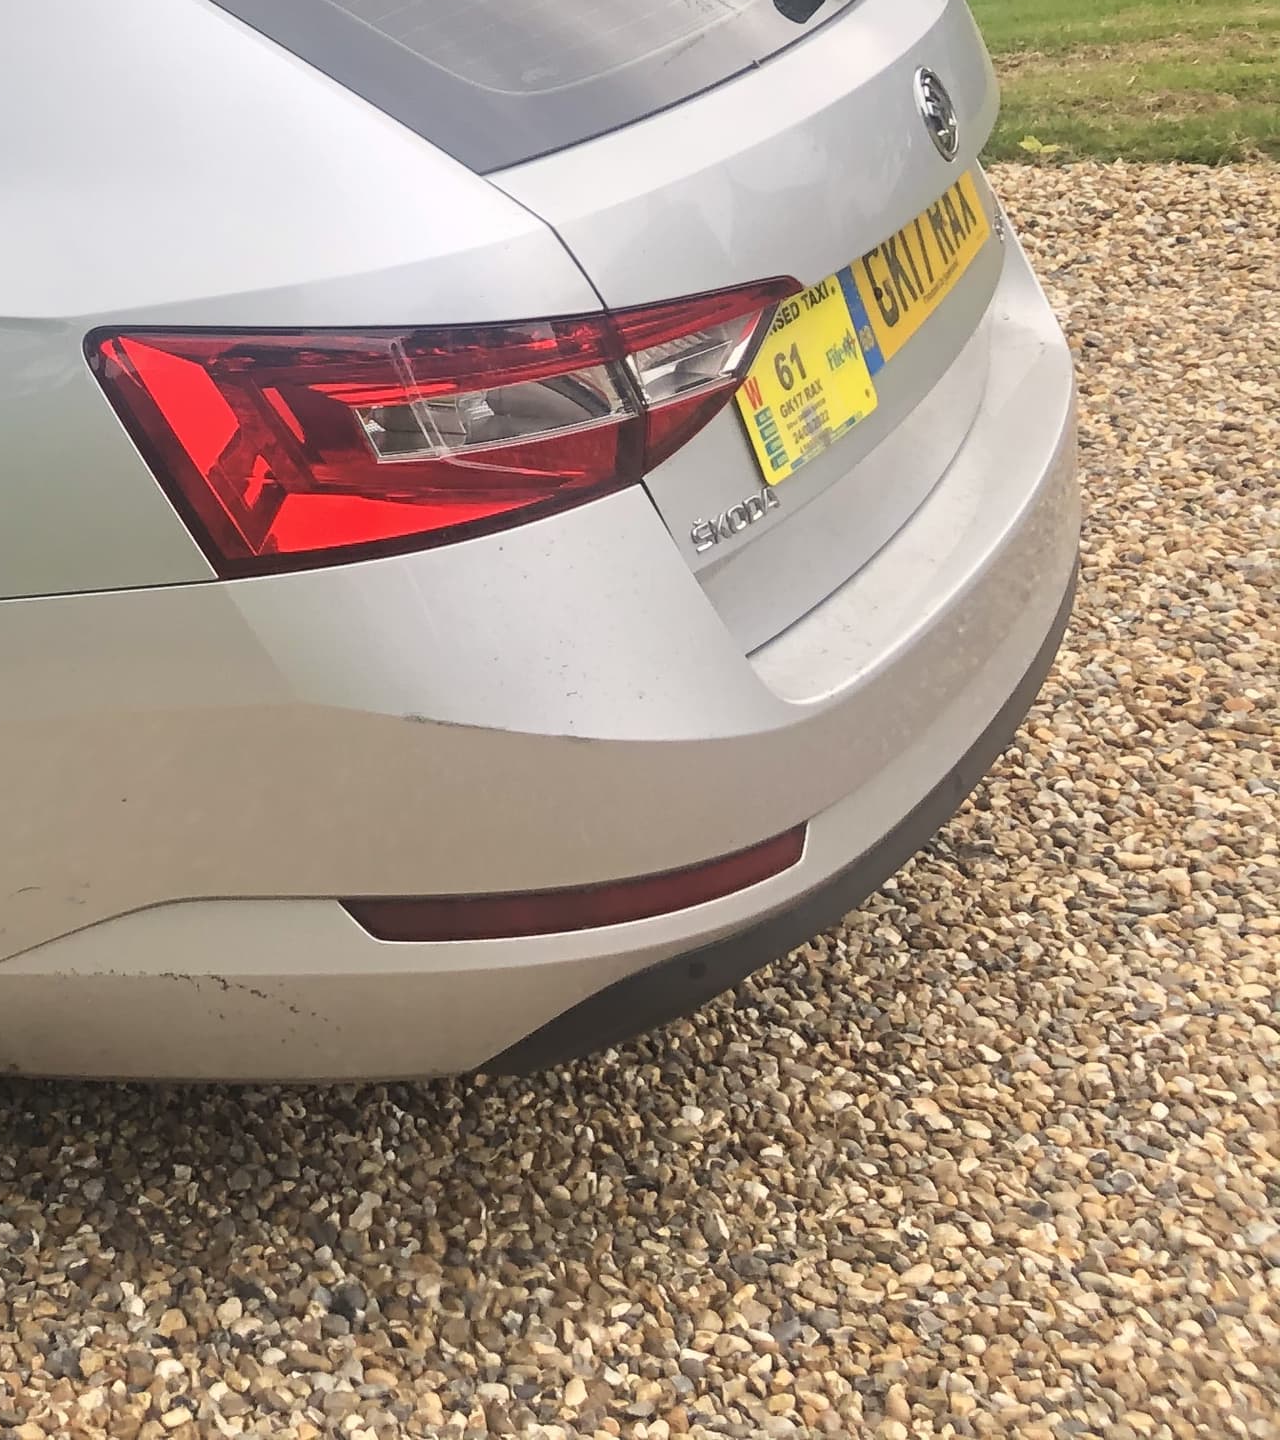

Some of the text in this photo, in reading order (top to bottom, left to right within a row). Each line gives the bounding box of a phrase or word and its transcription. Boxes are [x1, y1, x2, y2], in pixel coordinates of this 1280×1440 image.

[801, 281, 829, 311] TAXI
[774, 342, 807, 391] 61
[780, 391, 804, 418] GK17
[804, 378, 824, 401] RAX
